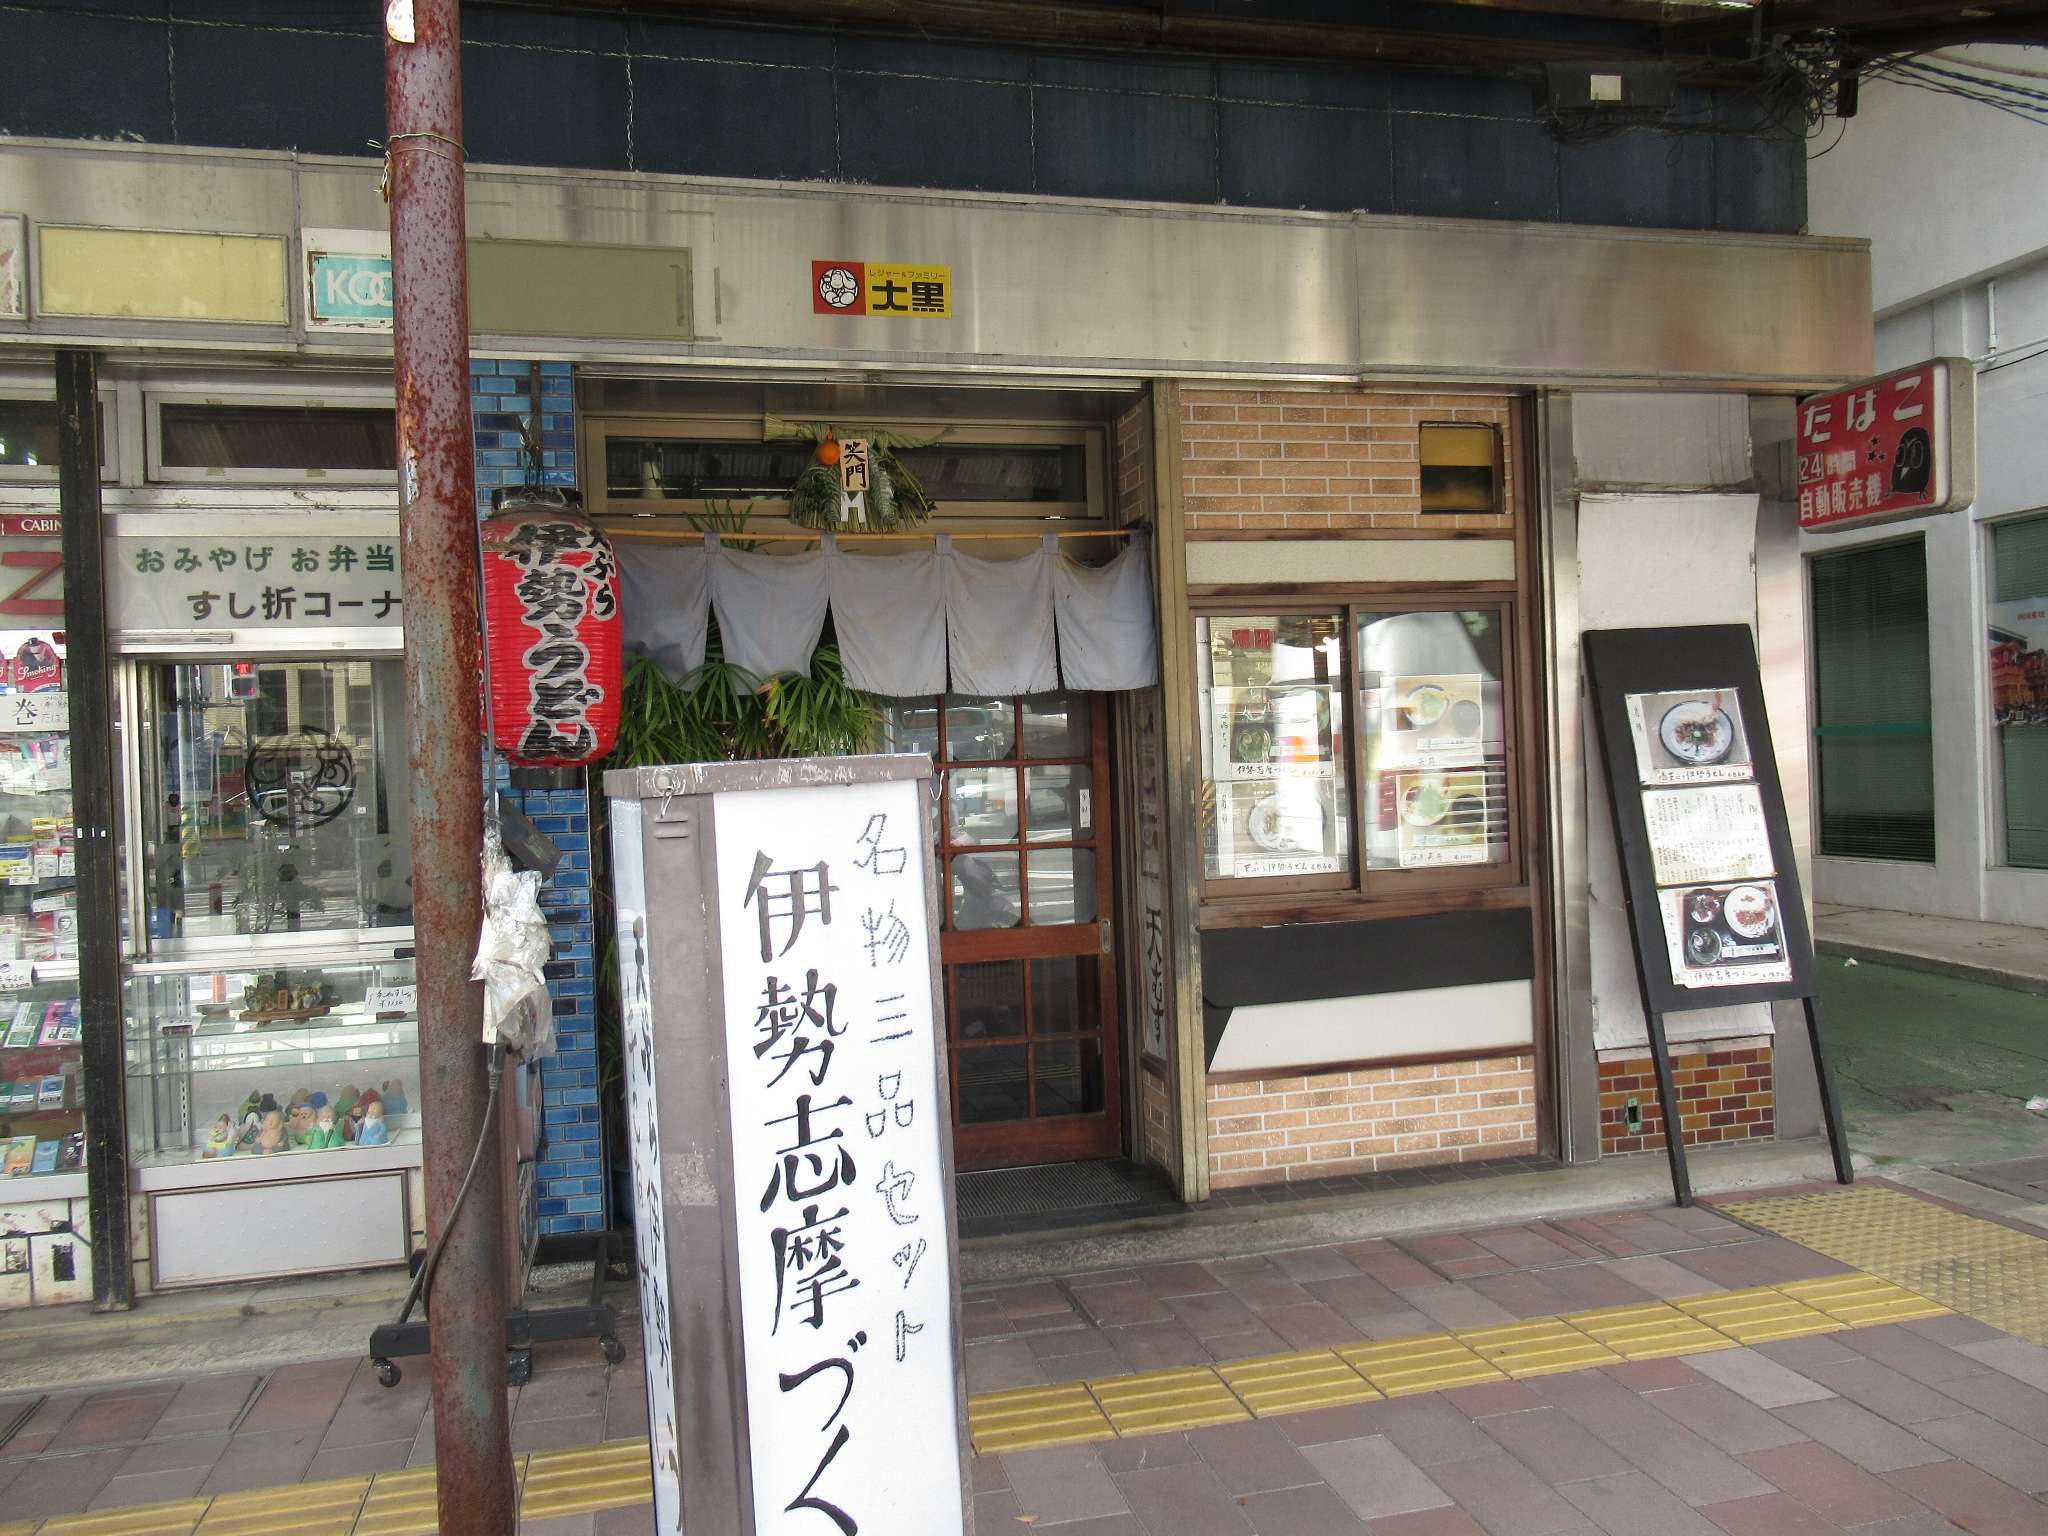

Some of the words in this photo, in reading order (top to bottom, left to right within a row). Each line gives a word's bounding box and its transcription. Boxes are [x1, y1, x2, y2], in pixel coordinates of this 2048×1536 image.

[871, 280, 944, 312] 大黒
[1803, 376, 1923, 443] たばこ
[843, 441, 866, 488] 笑門
[1801, 473, 1881, 520] 自動販売機
[136, 546, 273, 573] おみやげ
[292, 544, 395, 572] お弁当
[501, 524, 602, 758] 伊勢うどん
[18, 665, 57, 680] Smoking
[1146, 903, 1164, 1043] 天むす
[853, 813, 926, 1361] 名物三品セット
[743, 848, 868, 1536] 伊勢志摩づく
